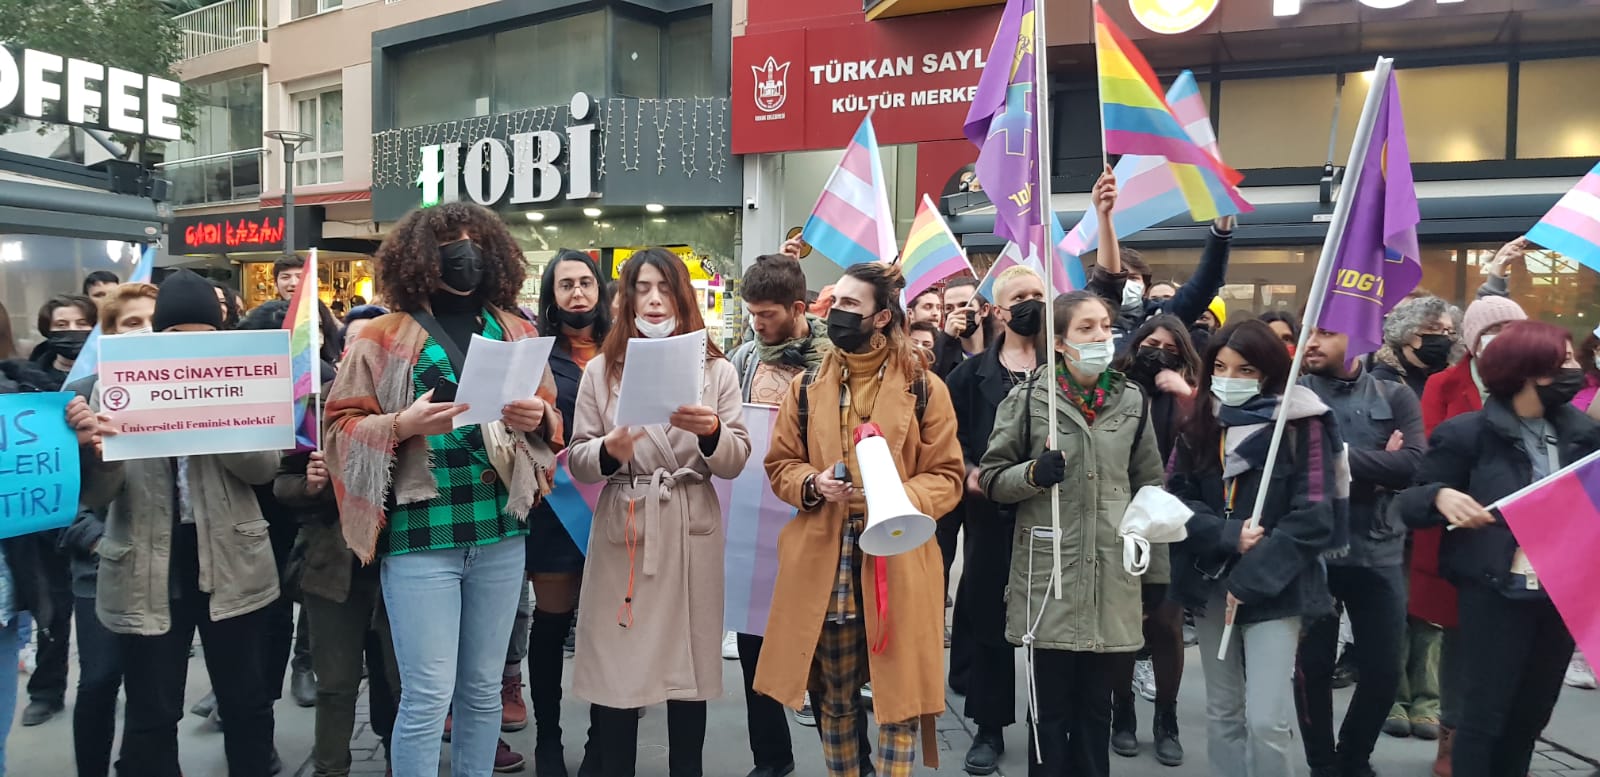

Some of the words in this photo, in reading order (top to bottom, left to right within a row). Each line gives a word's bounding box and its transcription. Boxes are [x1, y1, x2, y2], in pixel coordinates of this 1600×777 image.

[810, 56, 914, 85] TÜRKAN
[832, 91, 905, 113] KÜLTÜR
[226, 217, 286, 246] KAZAN
[114, 369, 170, 382] TRANS
[174, 362, 278, 380] CİNAYETLERİ
[151, 385, 244, 401] POLİTİKTİR!
[121, 421, 184, 432] Üniversiteli
[186, 418, 231, 429] Feminist
[233, 415, 276, 426] Kolektif
